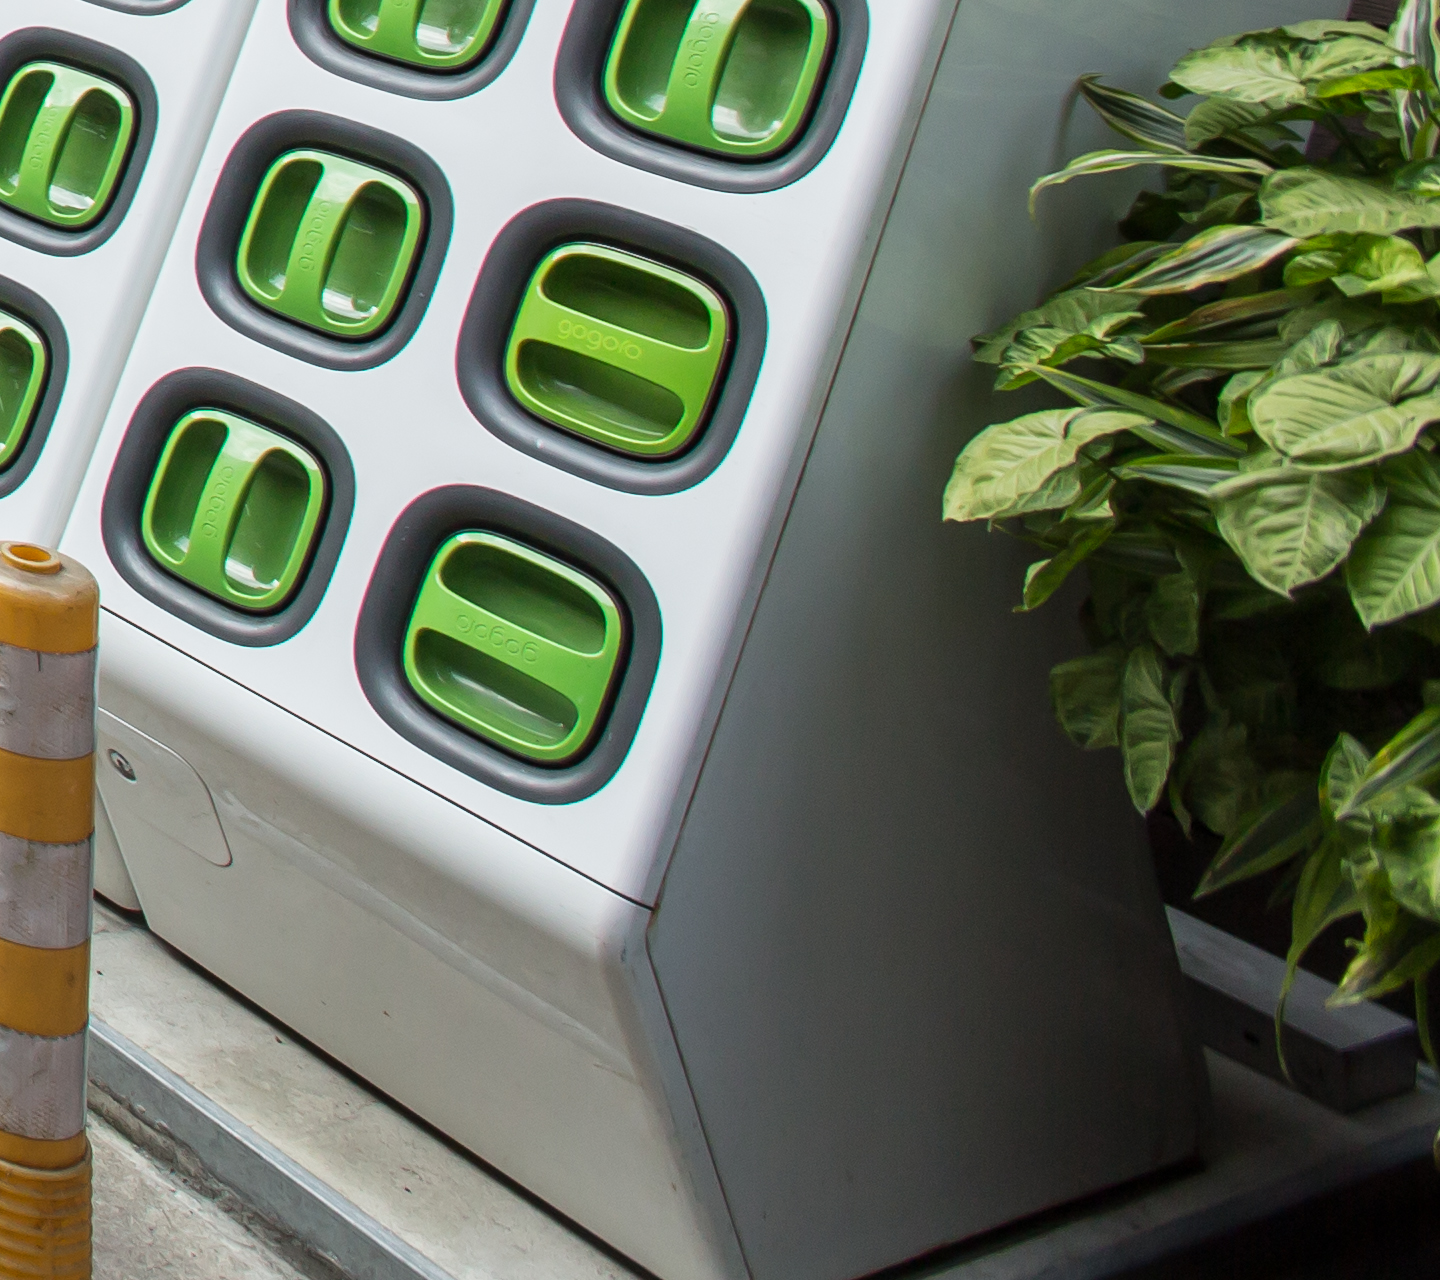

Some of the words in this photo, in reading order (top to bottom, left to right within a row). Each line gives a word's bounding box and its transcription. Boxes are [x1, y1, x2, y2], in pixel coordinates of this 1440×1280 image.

[683, 11, 719, 89] gogoro
[298, 200, 332, 272] gogoro
[557, 319, 643, 360] gogoro
[203, 464, 235, 539] gogoro
[455, 613, 540, 663] gogoro
